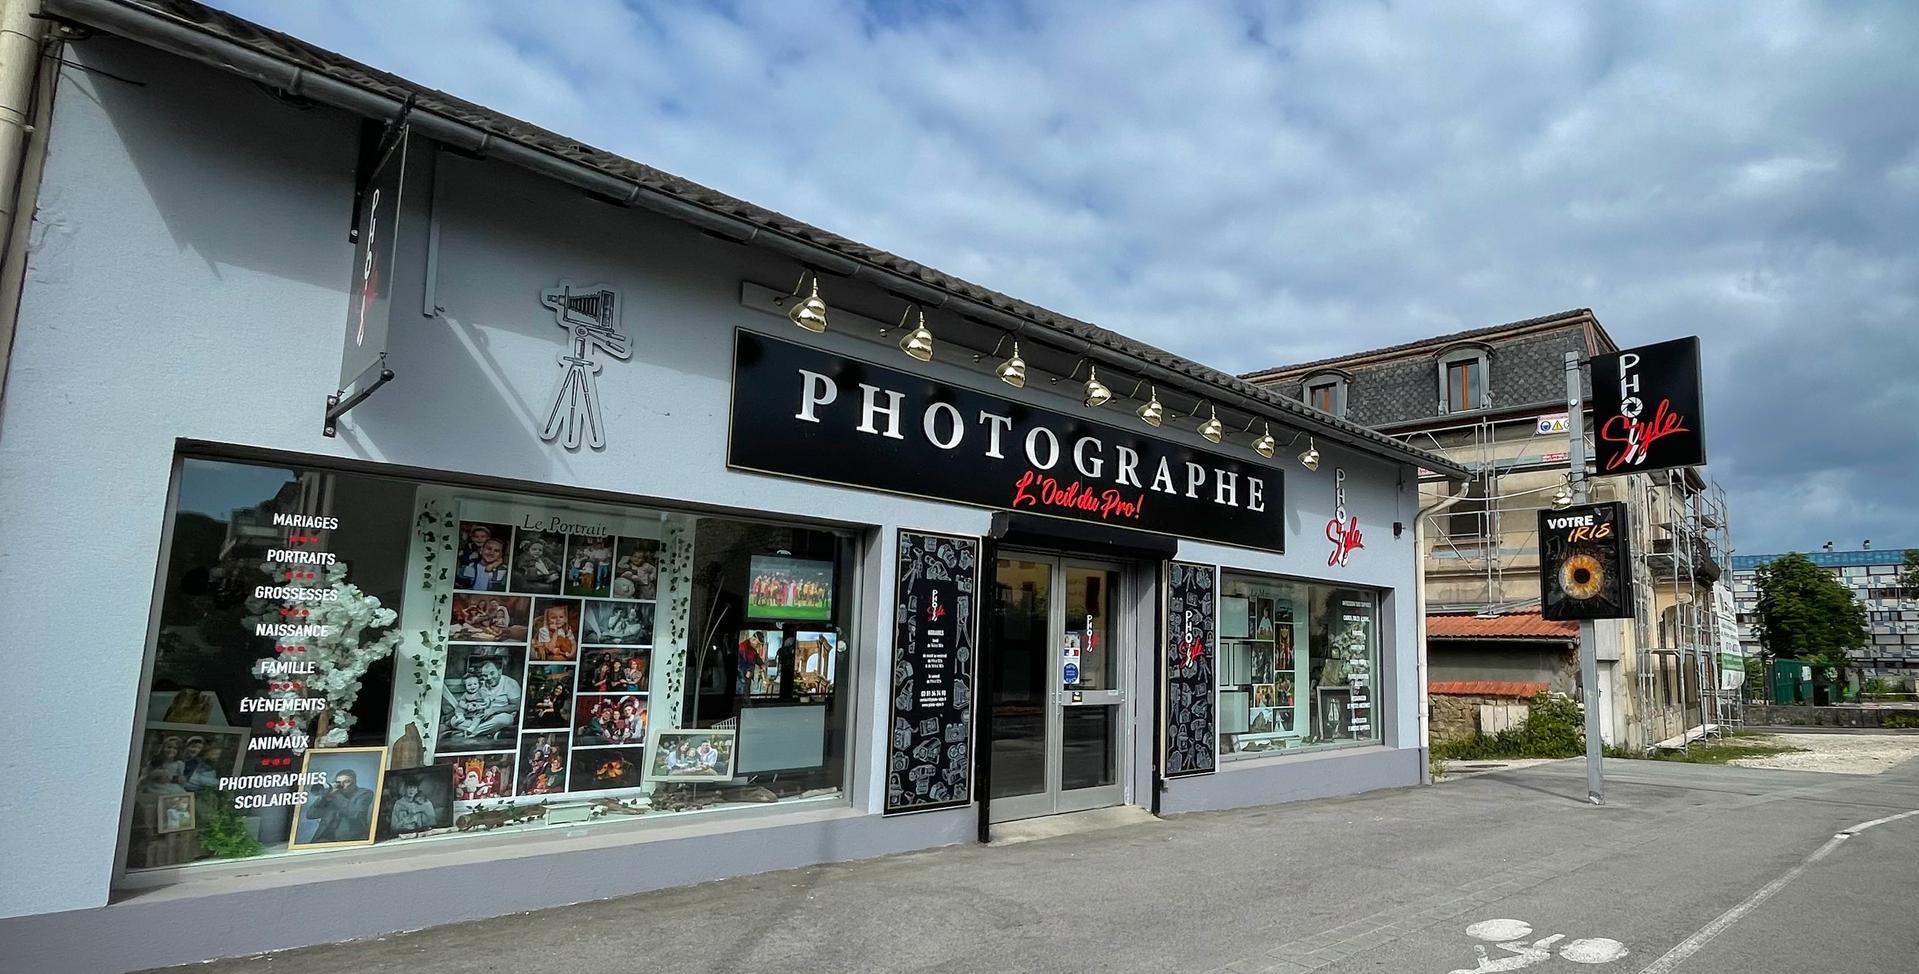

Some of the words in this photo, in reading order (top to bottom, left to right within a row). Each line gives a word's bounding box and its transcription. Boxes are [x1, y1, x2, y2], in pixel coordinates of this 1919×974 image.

[795, 368, 1265, 512] PHOTOGRAPHE
[1601, 399, 1691, 470] Style
[1077, 486, 1099, 512] du
[1101, 489, 1144, 519] Pro!
[273, 513, 338, 530] MARIAGES
[523, 514, 542, 530] Le
[550, 517, 607, 536] Portrait
[1547, 515, 1594, 530] VOTRE
[1567, 522, 1611, 543] IRIS
[266, 549, 336, 566] PORTRAITS
[254, 586, 338, 602] GROSSESSES
[255, 623, 329, 638] NAISSANCE
[260, 661, 316, 676] FAMILLE
[239, 696, 327, 713] ÉVÈNEMENTS
[248, 735, 310, 751] ANIMAUX
[218, 771, 328, 791] PHOTOGRAPHIES
[234, 792, 308, 810] SCOLAIRES
